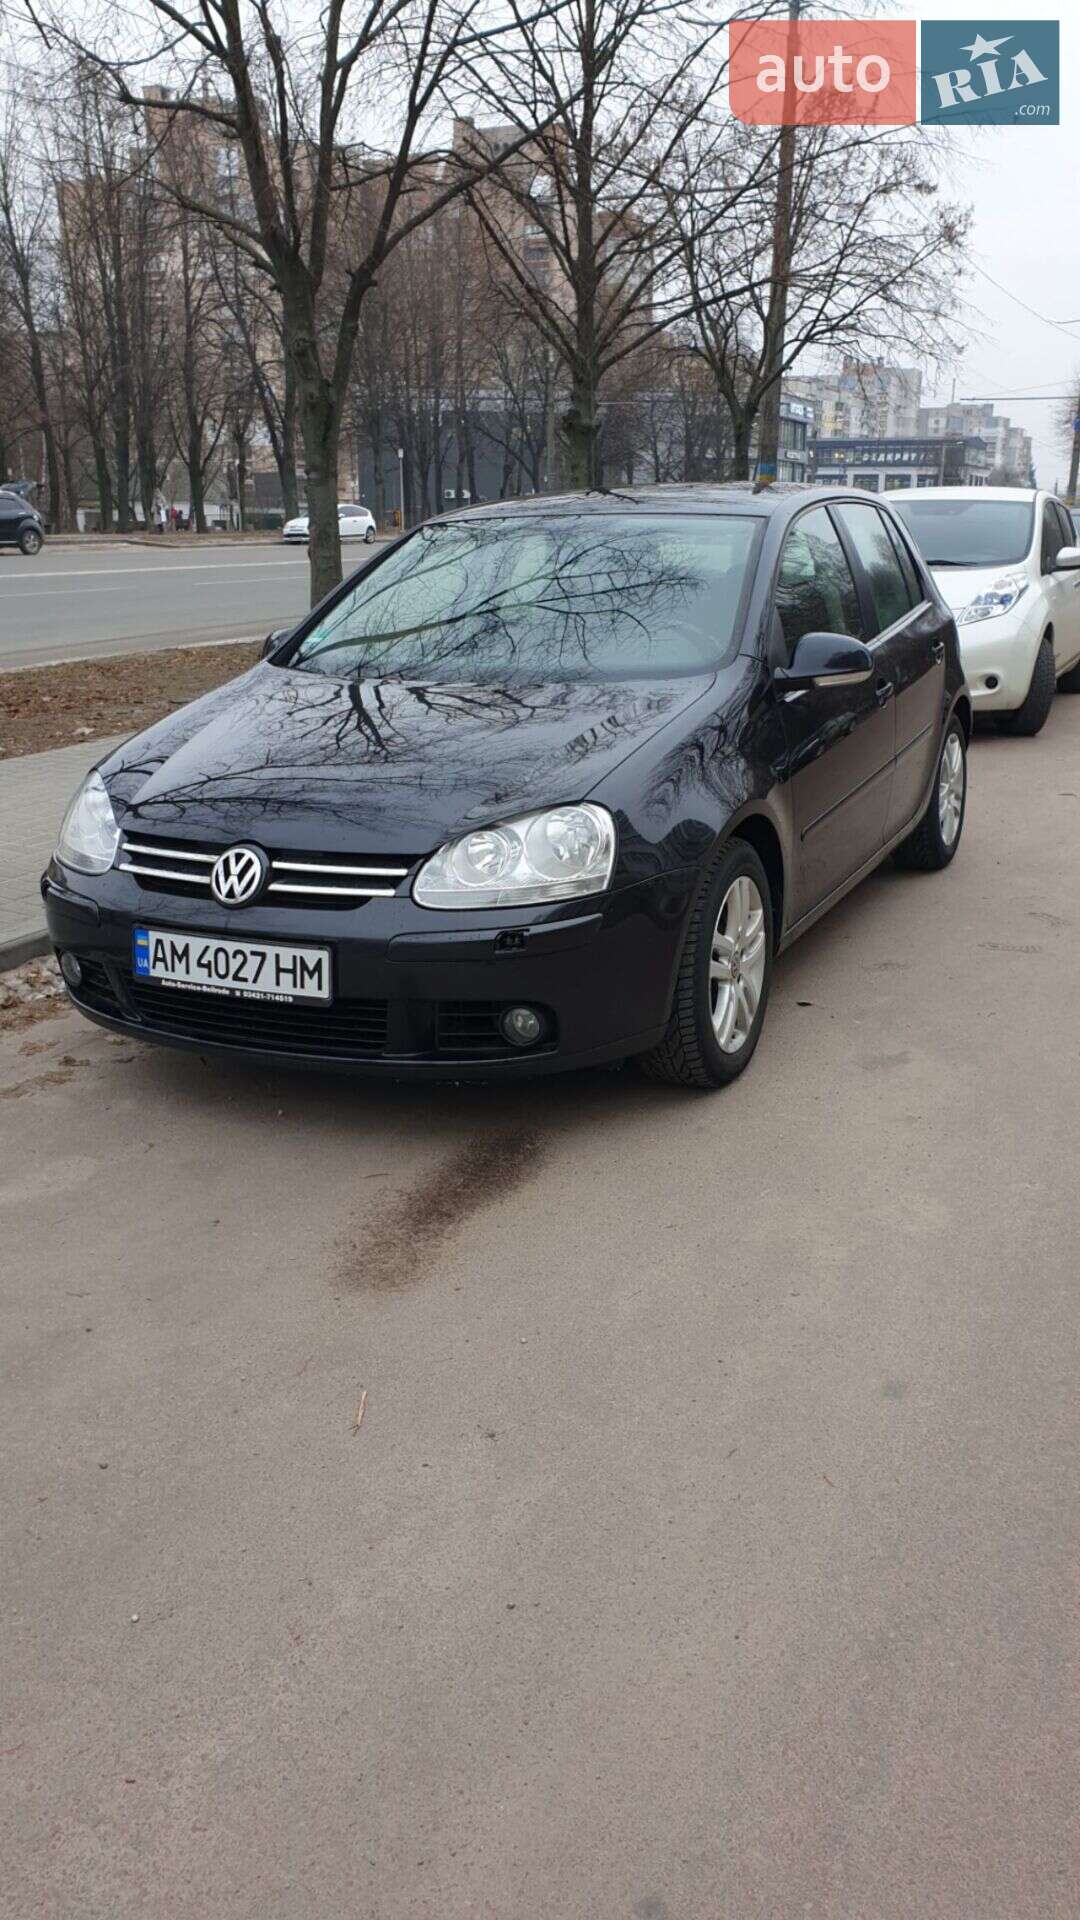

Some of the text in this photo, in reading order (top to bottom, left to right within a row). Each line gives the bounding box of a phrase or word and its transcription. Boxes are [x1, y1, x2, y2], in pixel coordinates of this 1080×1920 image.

[138, 957, 148, 968] UA
[152, 938, 323, 991] AM 4027 HM
